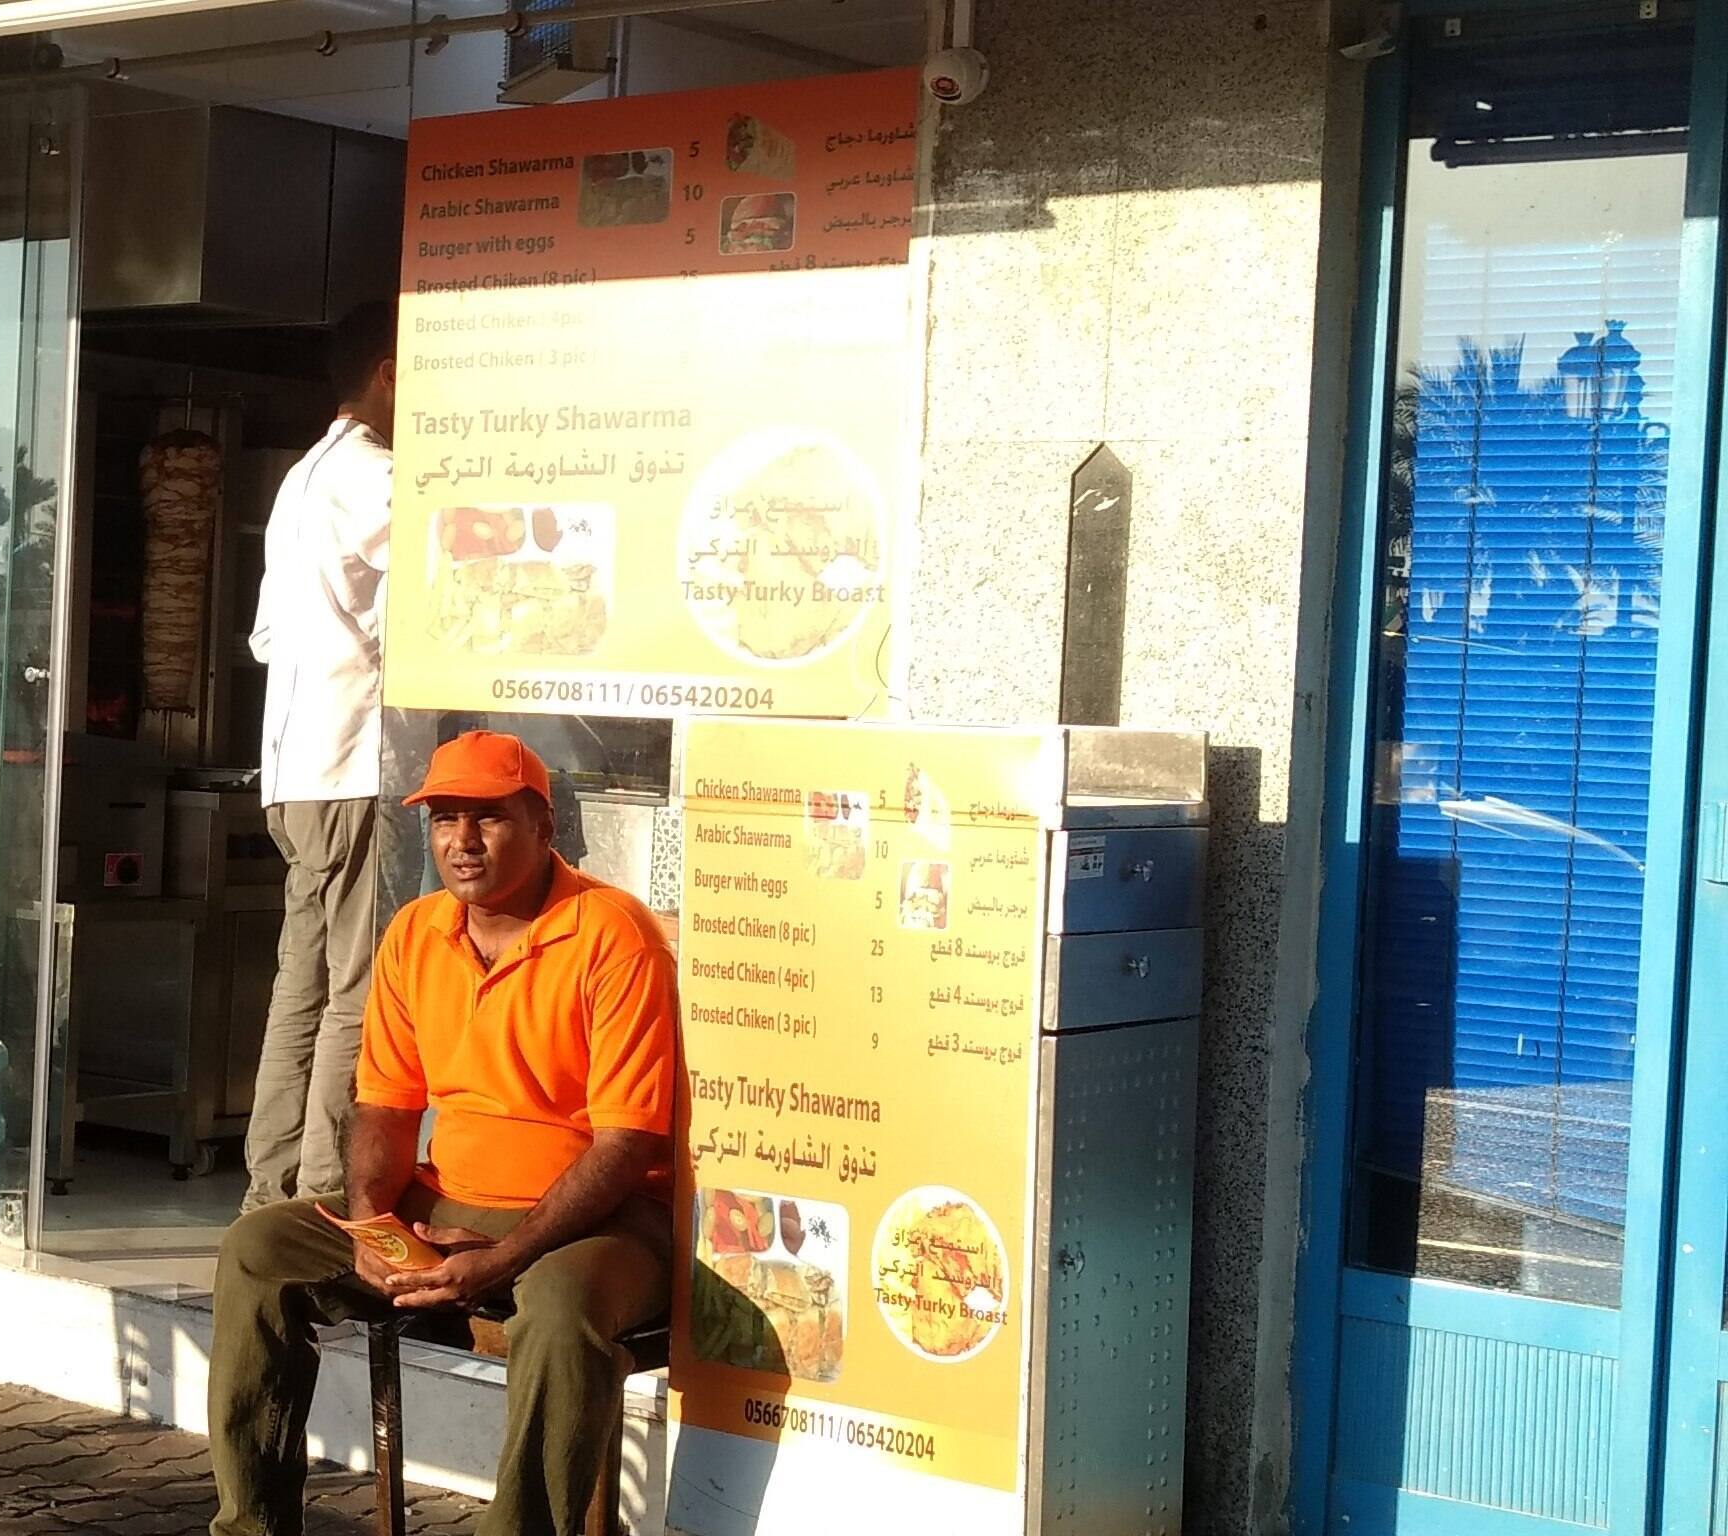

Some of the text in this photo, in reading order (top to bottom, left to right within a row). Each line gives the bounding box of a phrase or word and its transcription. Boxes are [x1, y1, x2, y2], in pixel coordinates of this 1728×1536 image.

[688, 141, 701, 158] 5
[422, 154, 575, 181] Chicken Shawarma
[683, 184, 703, 202] 10
[419, 195, 561, 220] Arabic Shawarma
[418, 235, 555, 260] Burger with eggs
[684, 228, 697, 245] 5
[416, 275, 478, 295] Brosted
[481, 270, 540, 290] Chiken
[415, 315, 476, 334] Brosted
[480, 311, 535, 330] Chiken
[413, 351, 474, 371] Brosted
[478, 349, 534, 369] Chiken
[411, 405, 692, 440] Tasty Turky Shawarma
[415, 455, 492, 495] التركي
[629, 449, 685, 483] تذوق
[681, 580, 886, 607] Tasty Turky Broast
[640, 683, 775, 710] 065420204
[695, 778, 802, 804] Chicken Shawarma
[878, 789, 886, 809] 5
[695, 823, 793, 848] Arabic Shawarma
[875, 840, 889, 859] 10
[694, 868, 788, 898] Burger with eggs
[875, 891, 883, 909] 5
[693, 913, 736, 935] Brosted
[737, 917, 776, 939] Chiken
[871, 939, 884, 957] 25
[955, 937, 963, 956] 8
[692, 958, 734, 980] Brosted
[736, 962, 776, 985] Chiken
[870, 986, 883, 1003] 13
[954, 984, 962, 1005] 4
[690, 1002, 734, 1026] Brosted
[736, 1006, 775, 1031] Chiken
[871, 1032, 879, 1050] 9
[952, 1032, 960, 1052] 3
[690, 1070, 881, 1123] Tasty Turky Shawarma
[691, 1126, 747, 1171] التركي
[838, 1144, 877, 1184] تذوق
[874, 1288, 1008, 1325] Tasty Turky Broast
[846, 1420, 936, 1462] 065420204
